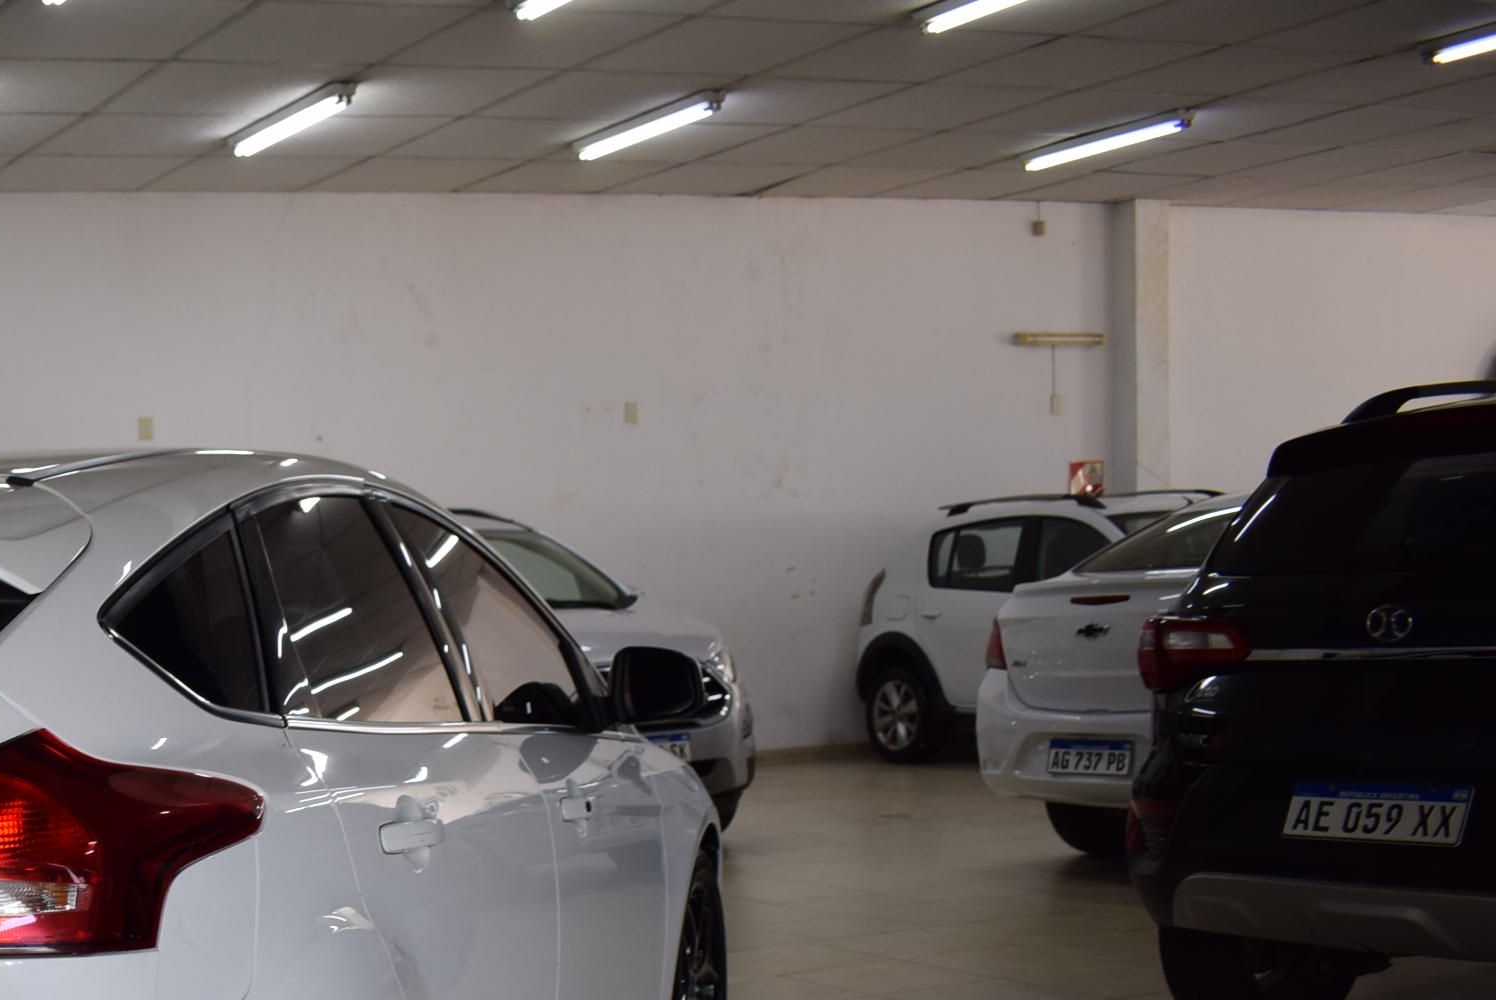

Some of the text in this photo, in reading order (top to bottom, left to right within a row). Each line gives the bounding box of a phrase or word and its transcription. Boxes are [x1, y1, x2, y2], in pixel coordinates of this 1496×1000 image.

[1051, 751, 1126, 772] AG 737 PB
[1292, 799, 1457, 839] AE 059 XX
